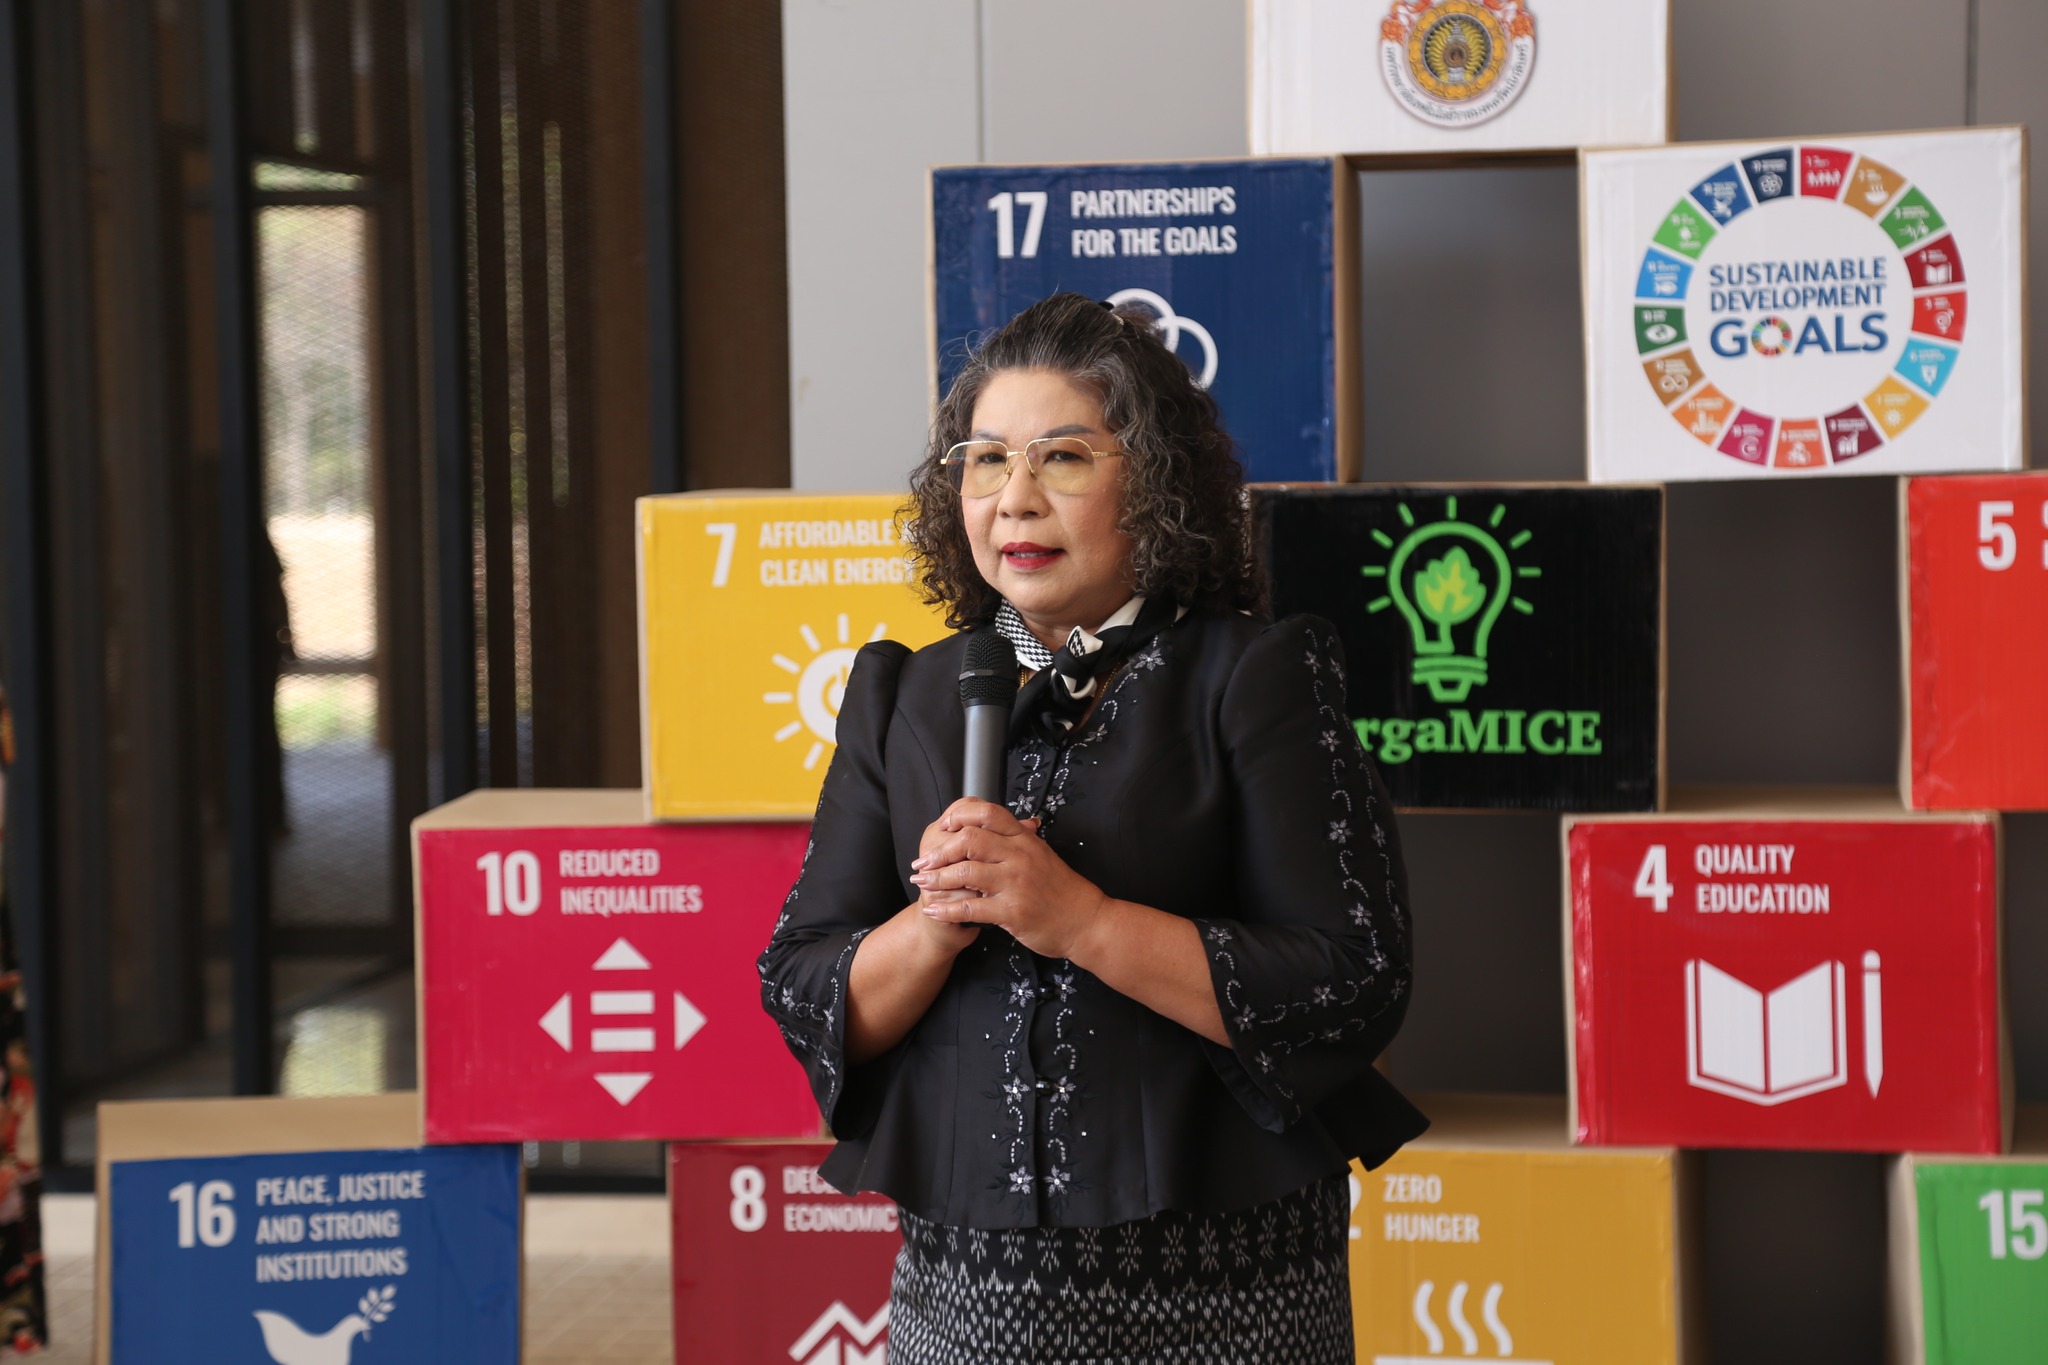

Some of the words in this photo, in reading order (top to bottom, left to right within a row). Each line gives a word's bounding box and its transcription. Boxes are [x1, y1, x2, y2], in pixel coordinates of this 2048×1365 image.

[1071, 186, 1236, 218] PARTNERSHIPS
[988, 192, 1047, 258] 17
[1072, 229, 1115, 257] FOR
[1119, 228, 1161, 255] THE
[1164, 225, 1237, 255] GOALS
[1710, 257, 1886, 287] SUSTAINABLE
[1711, 284, 1885, 312] DEVELOPMENT
[759, 519, 893, 548] AFFORDABLE
[1978, 501, 2016, 570] 5
[706, 523, 737, 587] 7
[760, 559, 829, 586] CLEAN
[559, 849, 660, 877] REDUCED
[1695, 845, 1794, 876] QUALITY
[477, 851, 540, 915] 10
[1634, 845, 1673, 912] 4
[561, 885, 702, 917] INEQUALITIES
[1697, 884, 1829, 913] EDUCATION
[257, 1176, 333, 1205] PEACE,
[337, 1171, 424, 1202] JUSTICE
[730, 1167, 766, 1231] 8
[1384, 1174, 1442, 1203] ZERO
[170, 1181, 235, 1248] 16
[256, 1215, 304, 1244] AND
[309, 1210, 399, 1241] STRONG
[784, 1203, 898, 1232] ECONOMIC
[1385, 1213, 1479, 1242] HUNGER
[1979, 1190, 2048, 1259] 15
[257, 1249, 407, 1282] INSTITUTIONS
